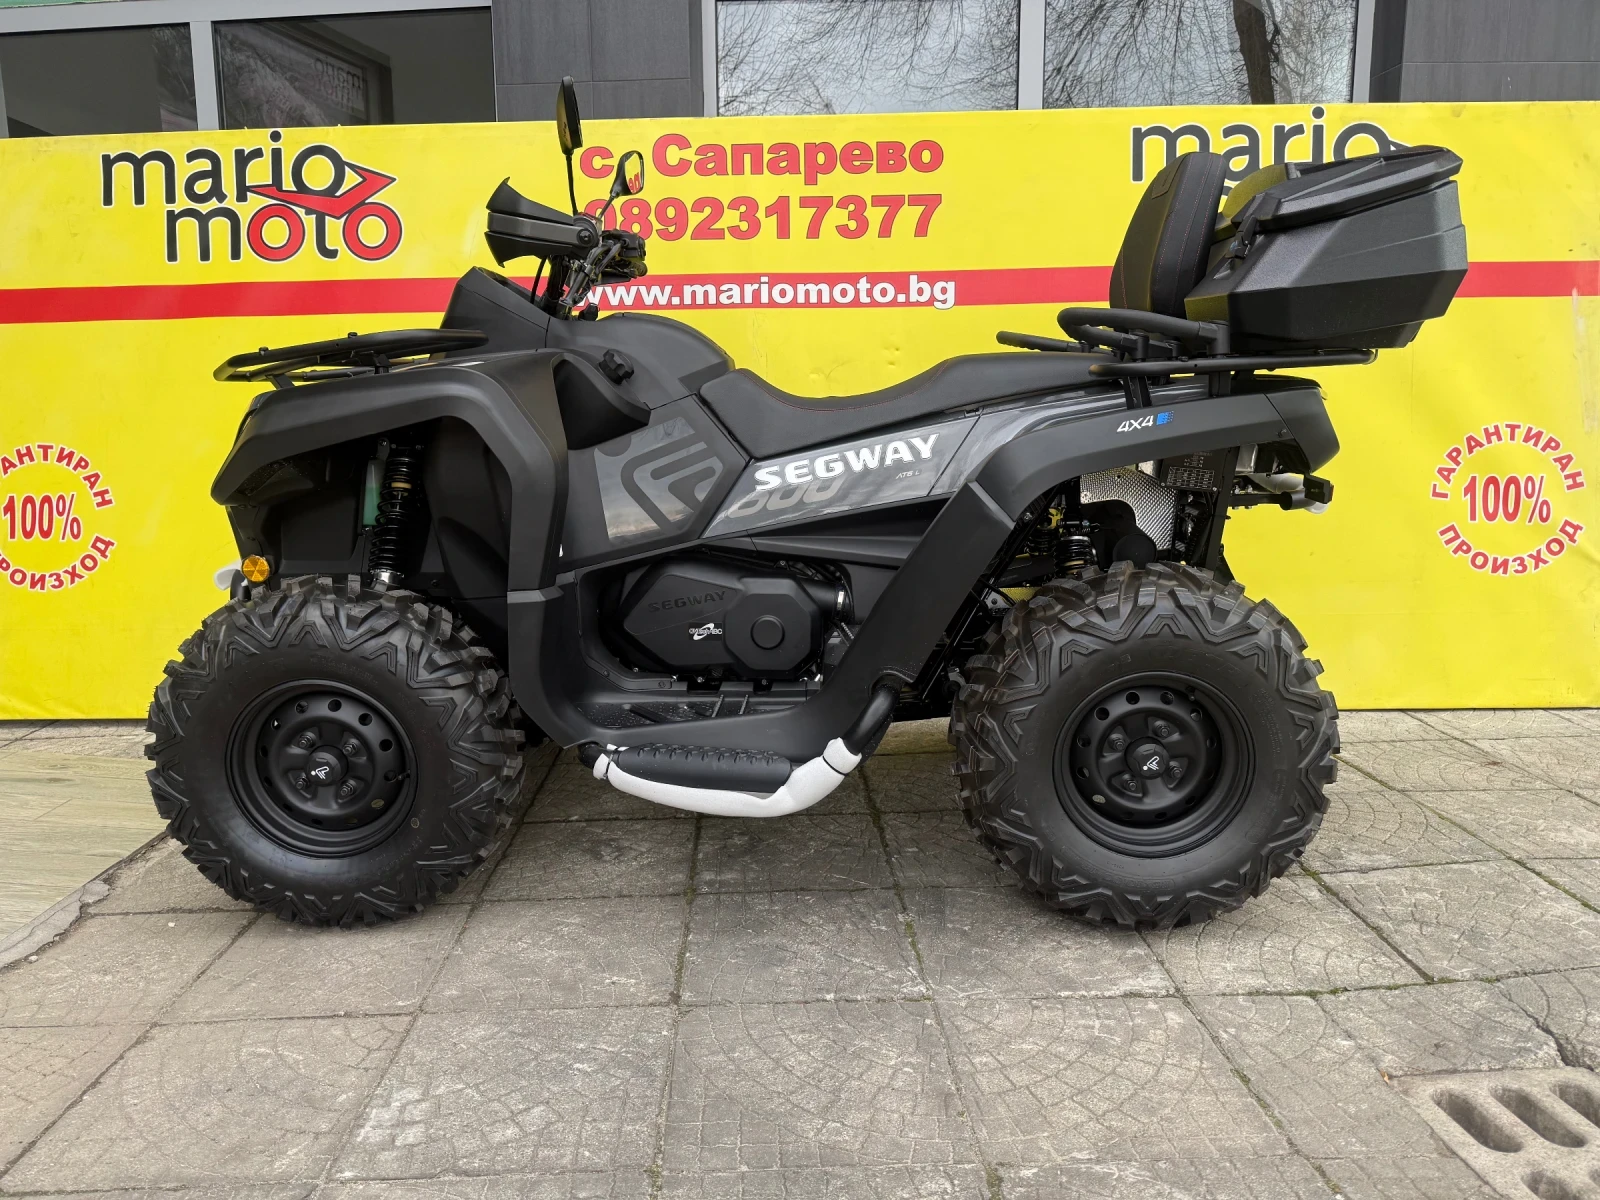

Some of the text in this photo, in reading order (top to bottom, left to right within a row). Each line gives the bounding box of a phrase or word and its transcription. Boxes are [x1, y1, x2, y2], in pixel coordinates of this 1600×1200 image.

[101, 130, 346, 206] mario
[652, 133, 944, 185] Сапарево
[166, 202, 403, 262] moto
[583, 194, 942, 241] 0892317377
[577, 275, 956, 309] www.mariomoto.bg
[754, 433, 940, 491] SEGWAY
[1432, 423, 1584, 499] ГАРАНТИРАН
[3, 493, 82, 541] 100%
[1463, 475, 1552, 524] 100%
[0, 535, 116, 591] РОИЗХОД
[1438, 519, 1584, 575] ПРОИЗХОД
[647, 590, 726, 613] SEGWAY
